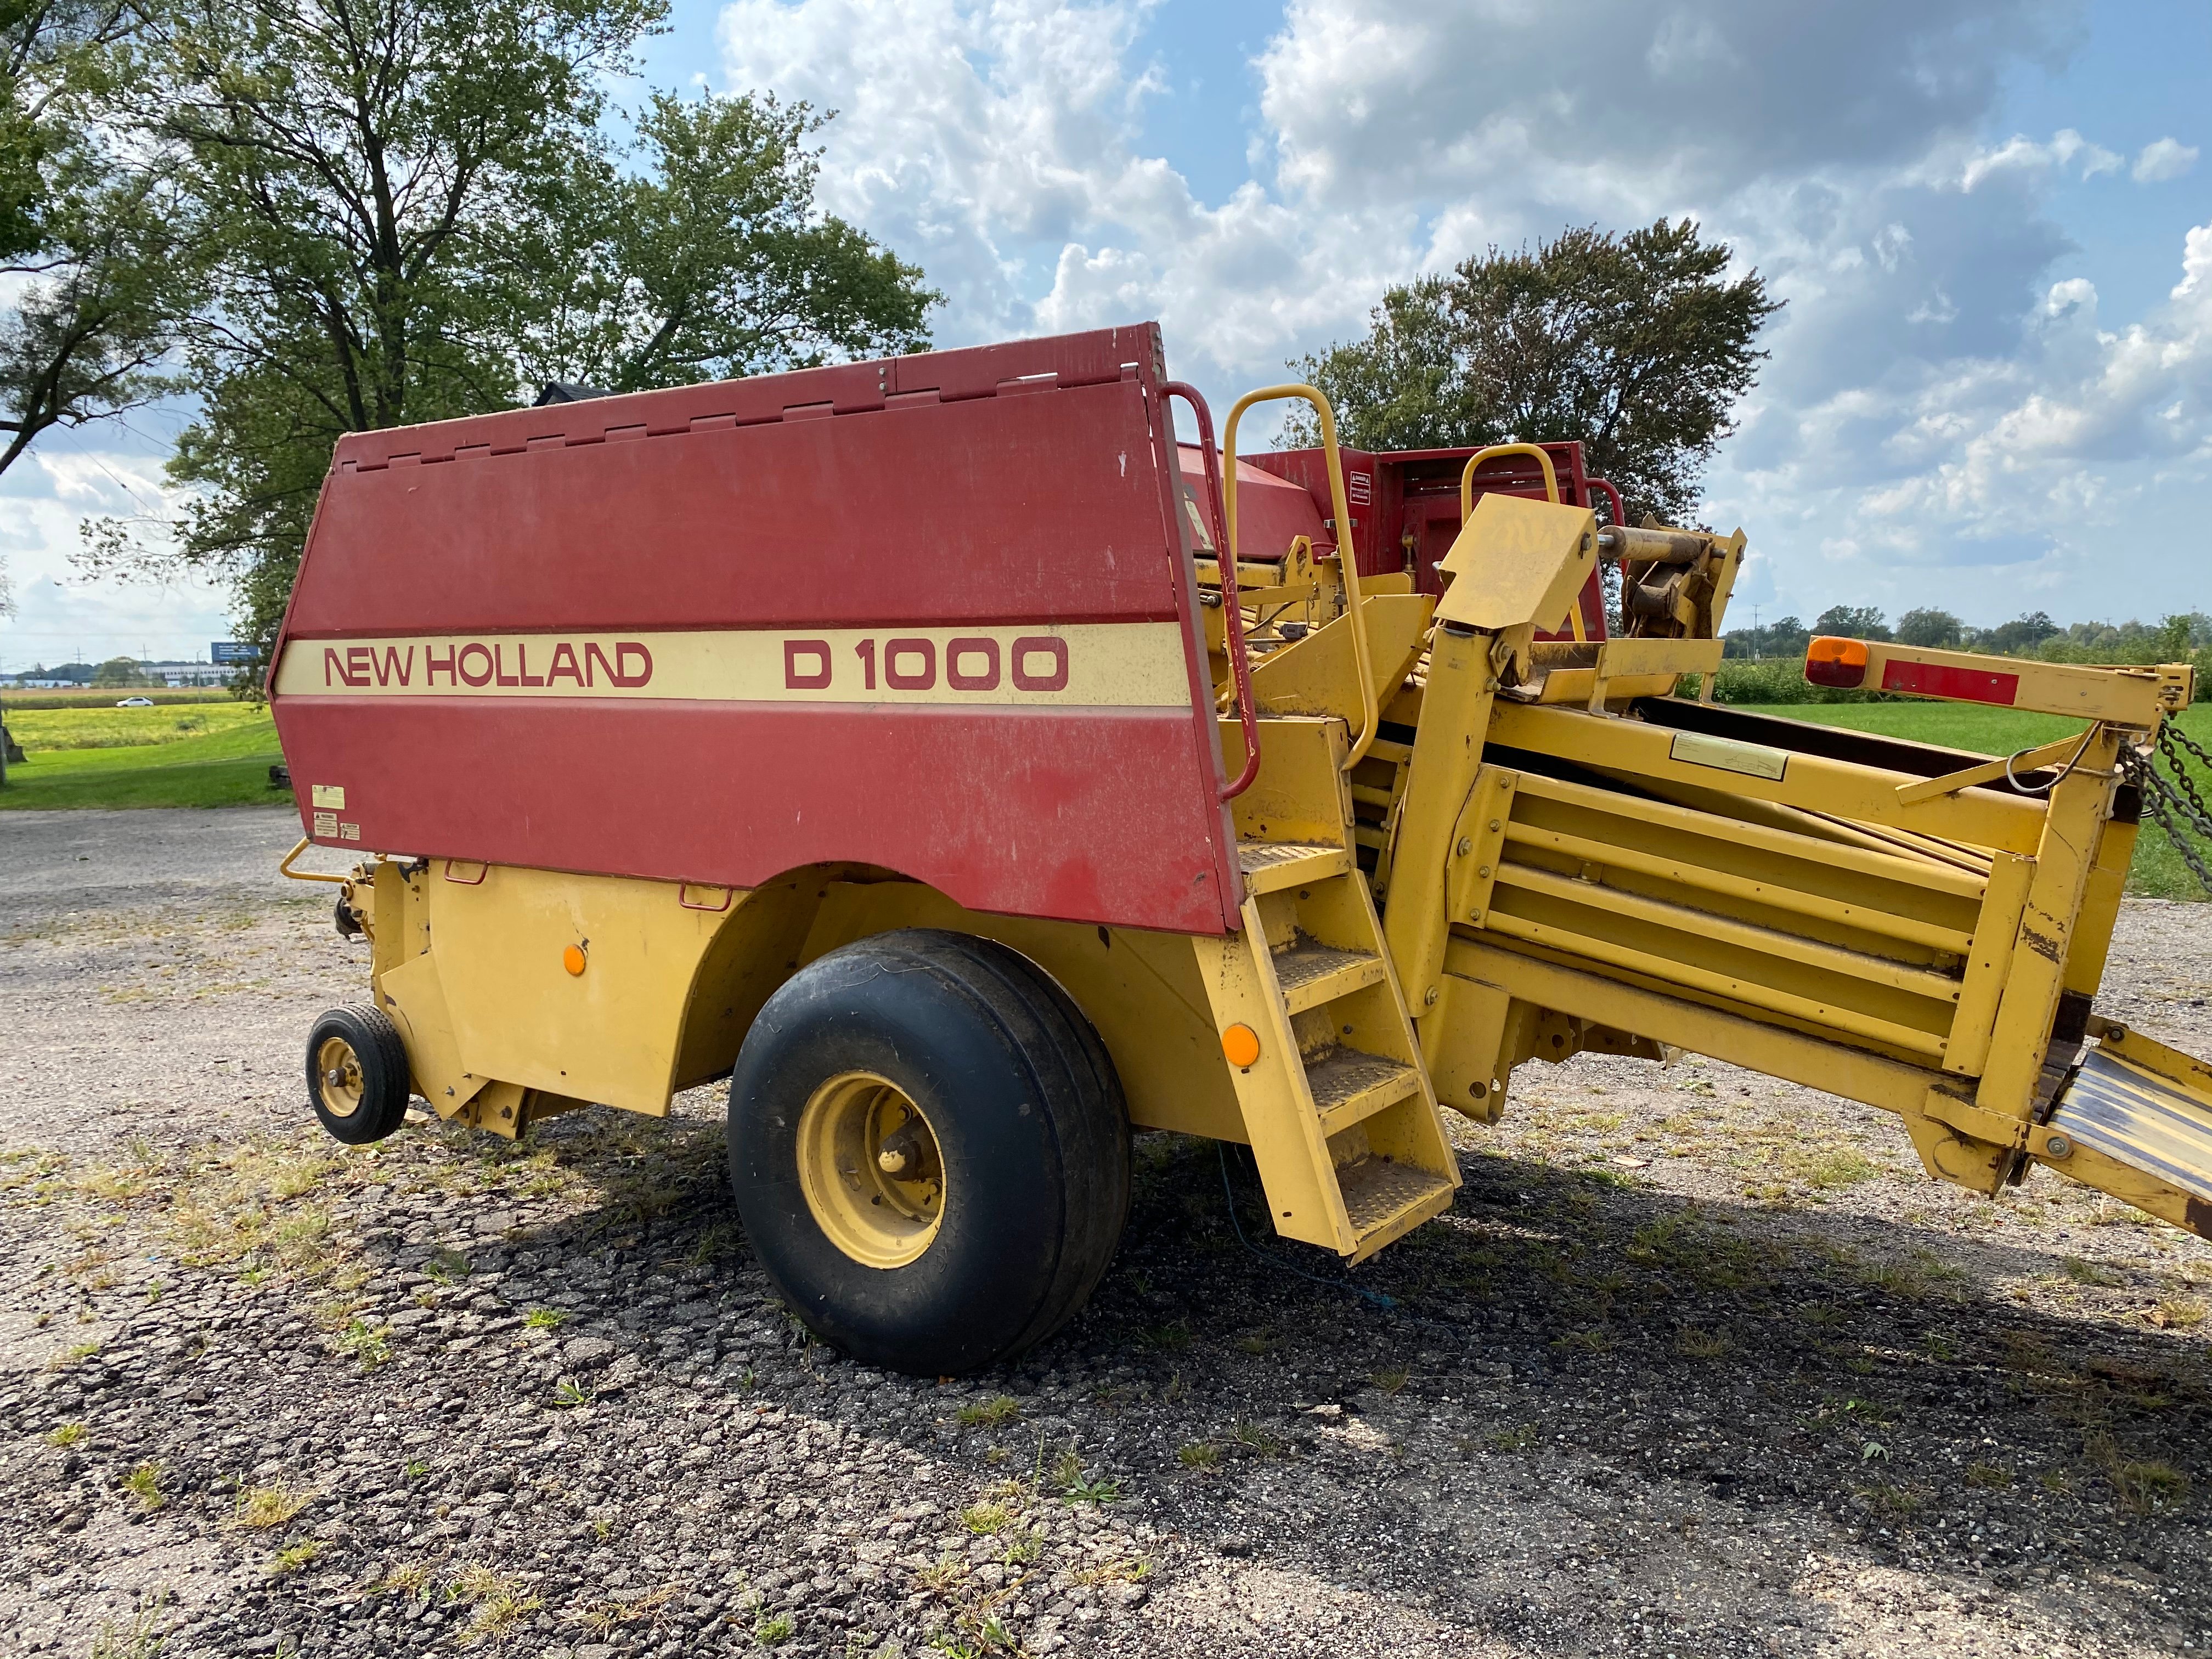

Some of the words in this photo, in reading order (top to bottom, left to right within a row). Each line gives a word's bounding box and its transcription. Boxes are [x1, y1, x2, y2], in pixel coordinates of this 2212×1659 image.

[325, 646, 414, 686] NEW
[426, 642, 652, 687] HOLLAND
[784, 640, 831, 689] D
[855, 637, 1068, 691] 1000
